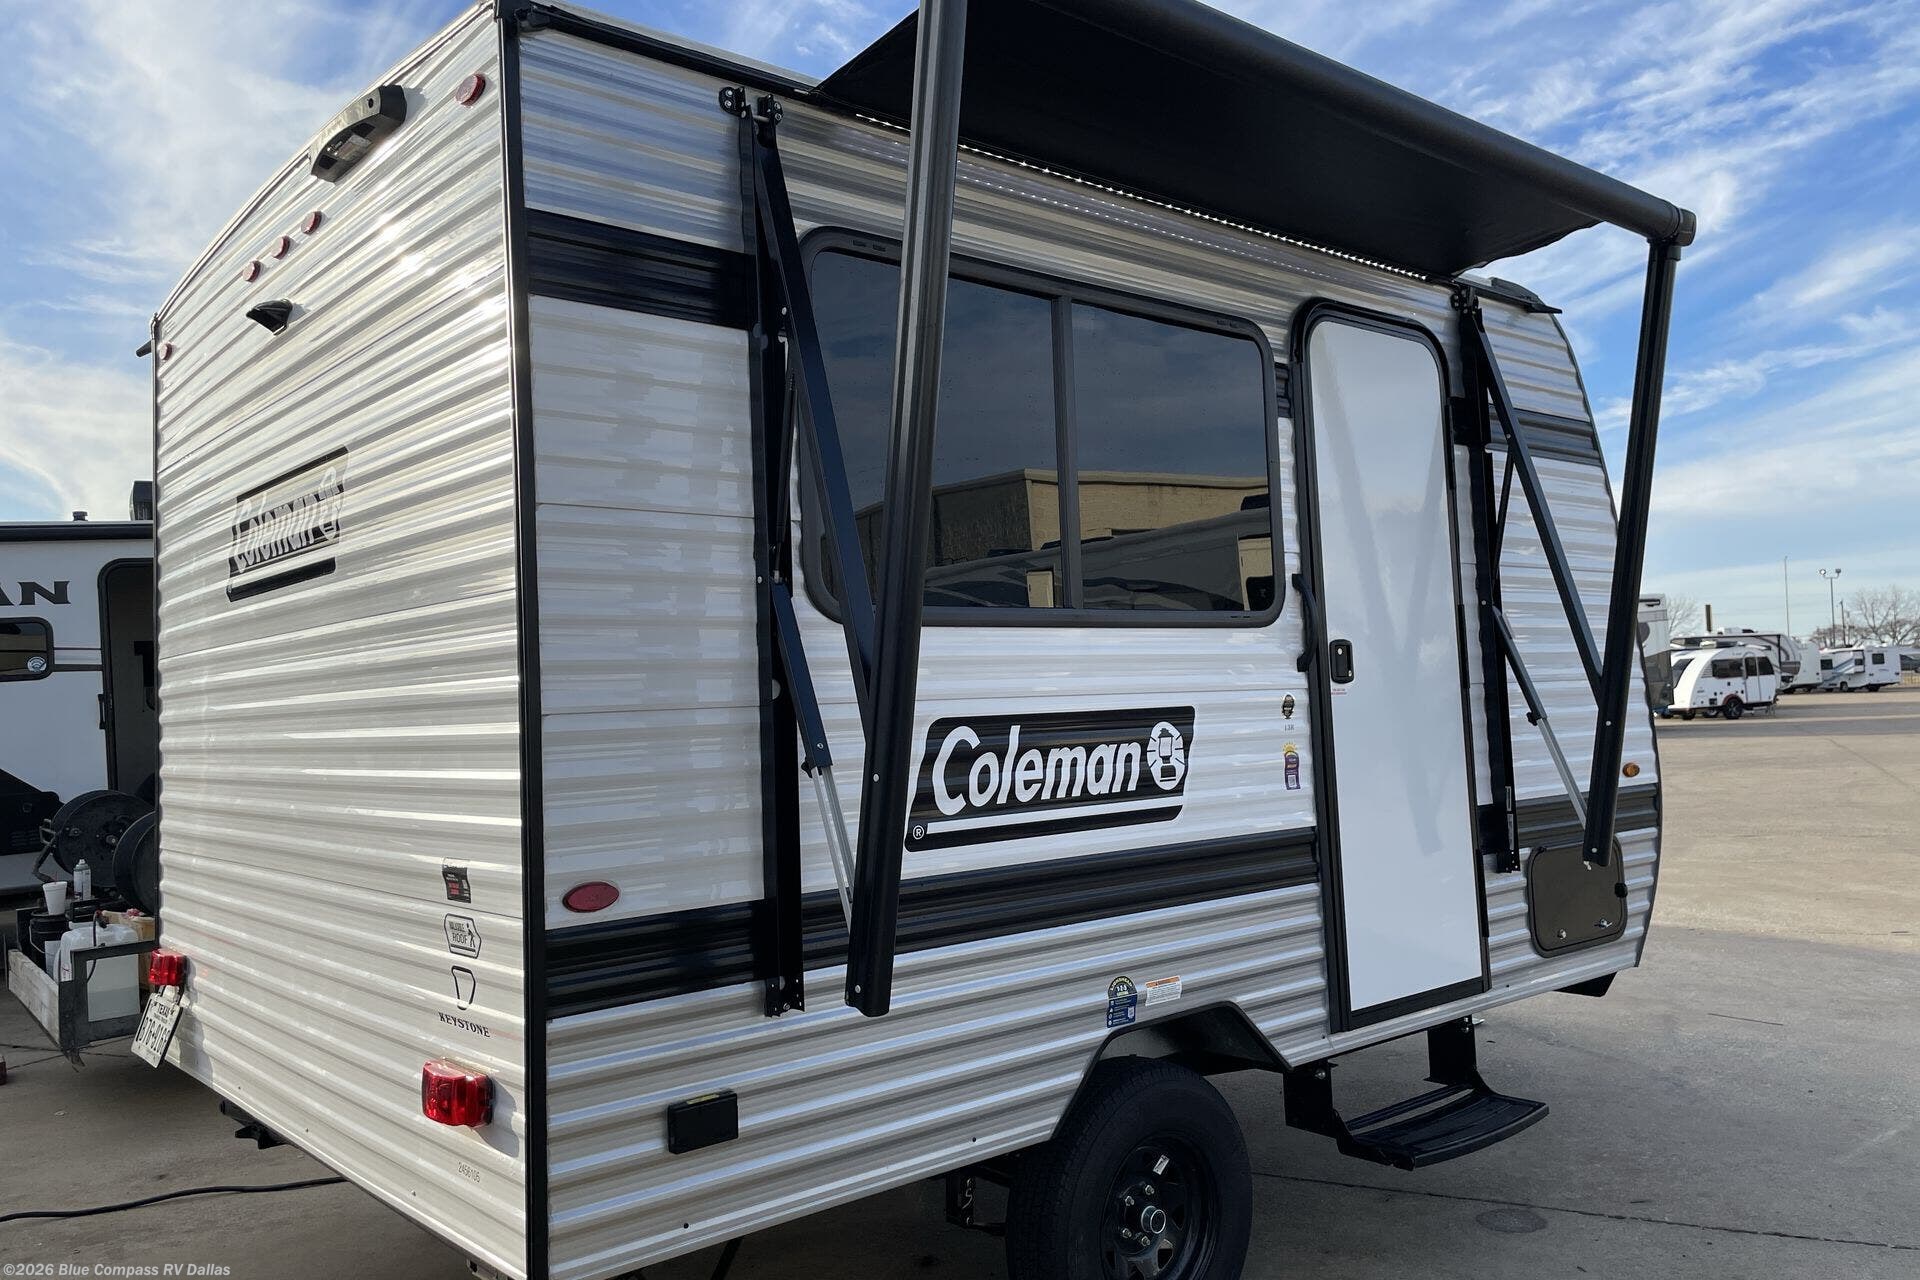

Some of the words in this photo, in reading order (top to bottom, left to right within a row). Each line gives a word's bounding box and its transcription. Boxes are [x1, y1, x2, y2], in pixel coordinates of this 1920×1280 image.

[233, 490, 316, 574] Coleman
[933, 723, 1143, 817] Coleman
[451, 932, 468, 945] ROOF
[437, 1012, 491, 1038] KEYSTONE
